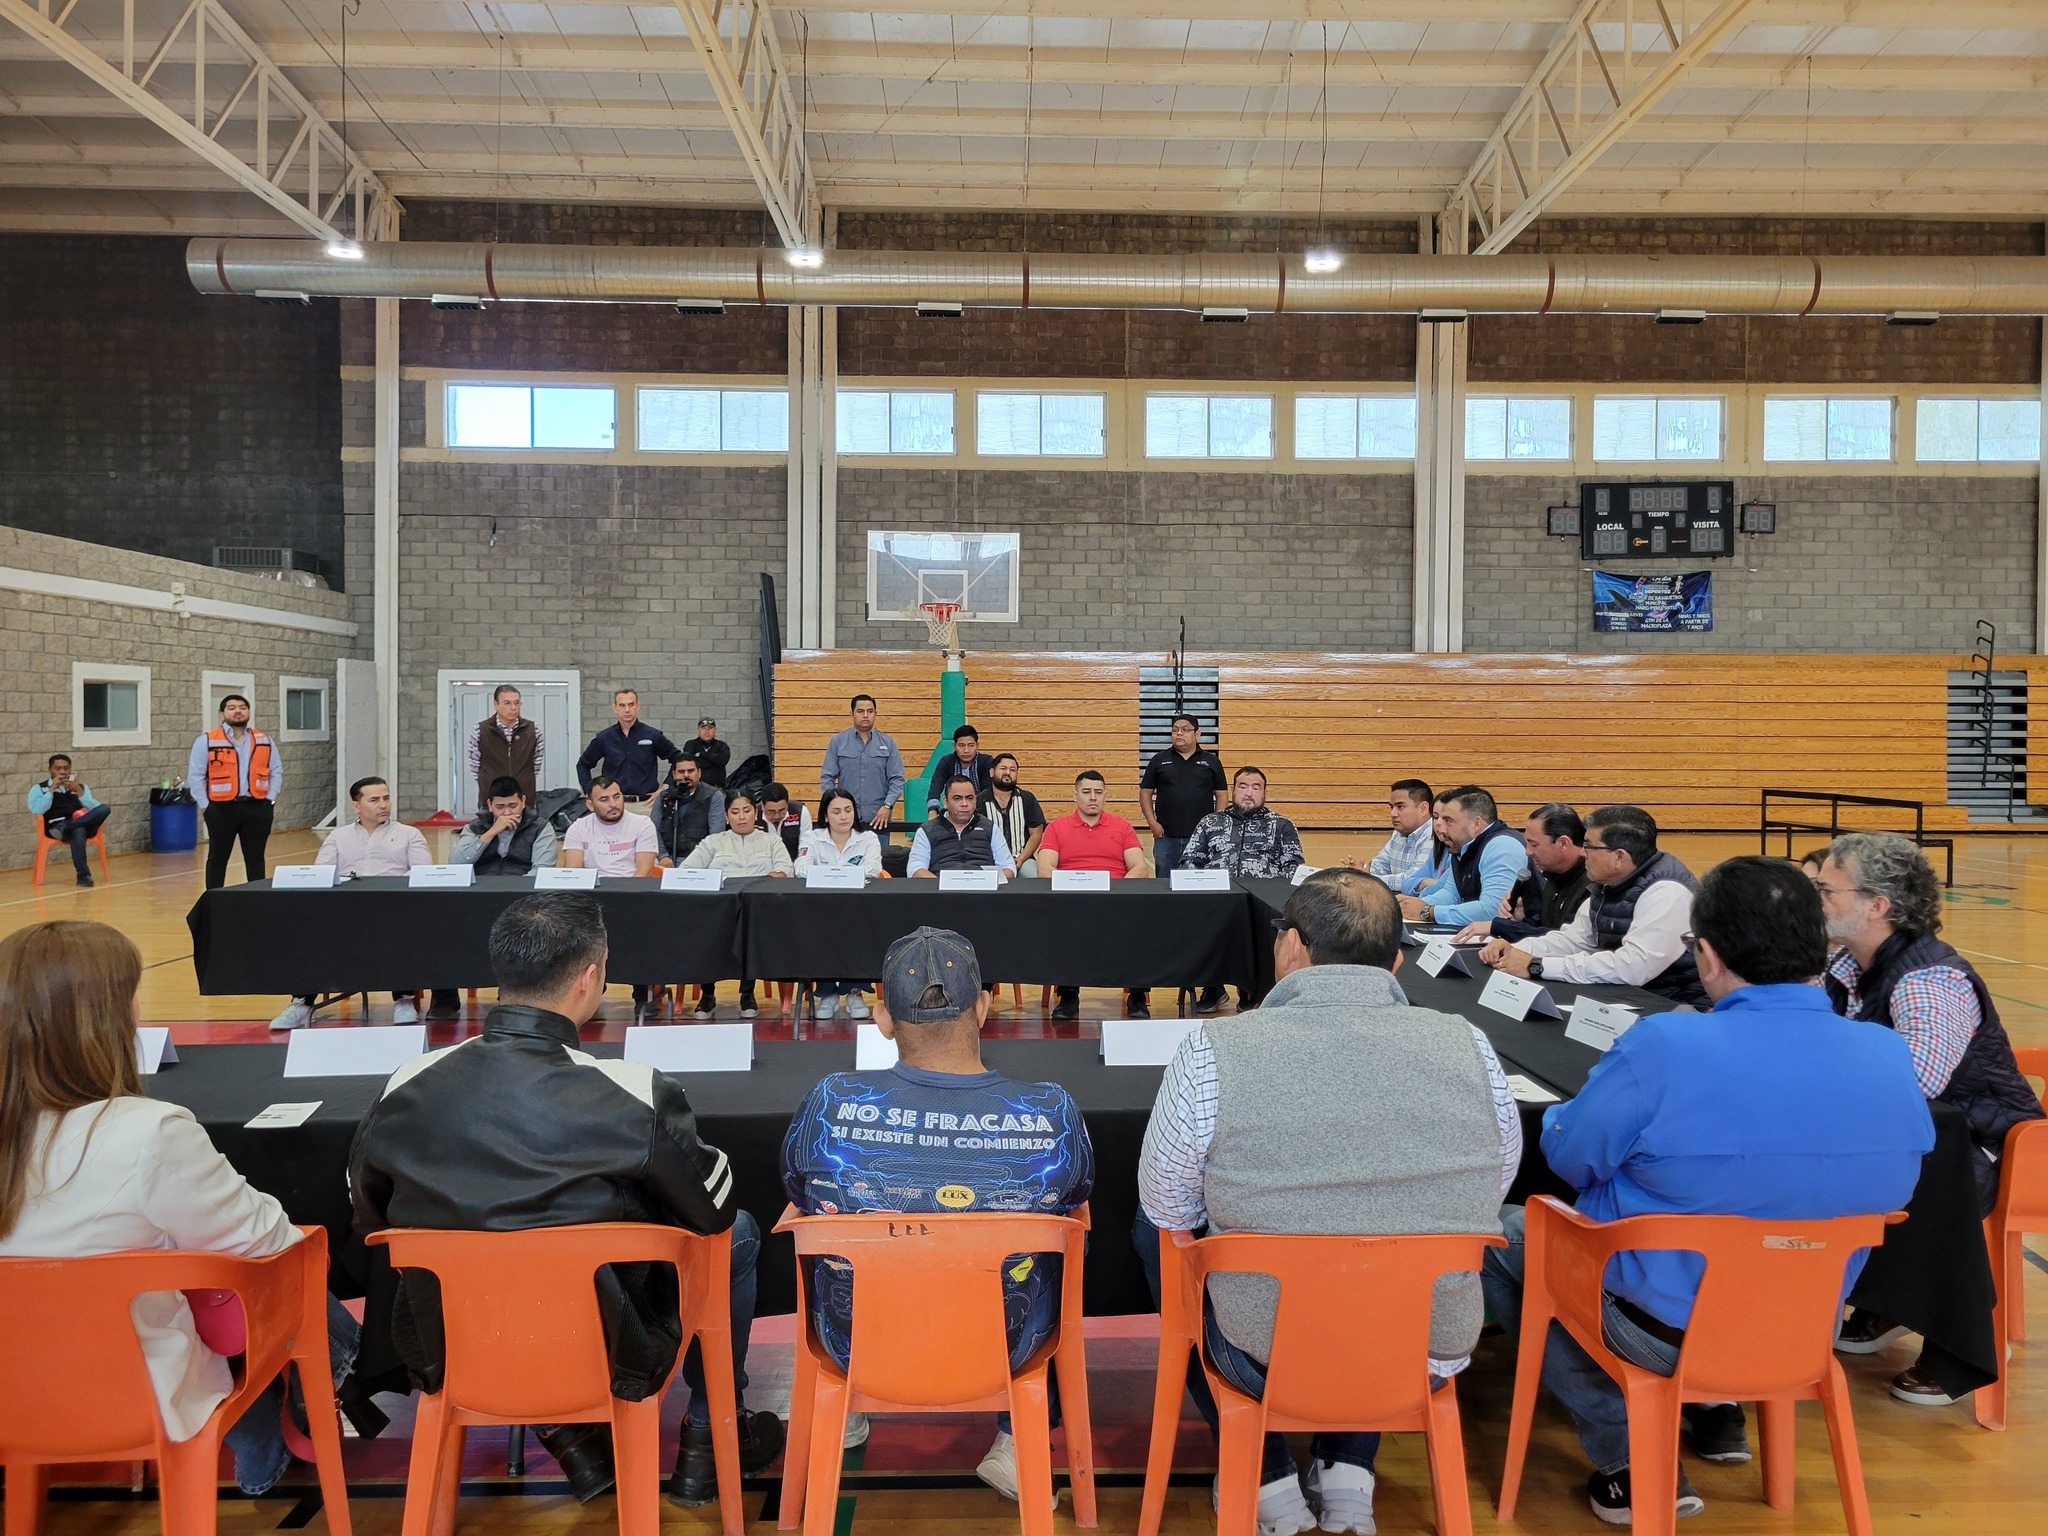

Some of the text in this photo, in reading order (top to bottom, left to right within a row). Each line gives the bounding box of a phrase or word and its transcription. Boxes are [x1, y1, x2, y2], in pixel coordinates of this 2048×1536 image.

[1596, 523, 1624, 531] LOCAL
[1693, 520, 1720, 528] VISITA
[837, 1102, 1054, 1132] NO SE FRACASA
[831, 1125, 1056, 1150] SI EXISTE UN COMIENZO
[942, 1191, 969, 1200] LUX
